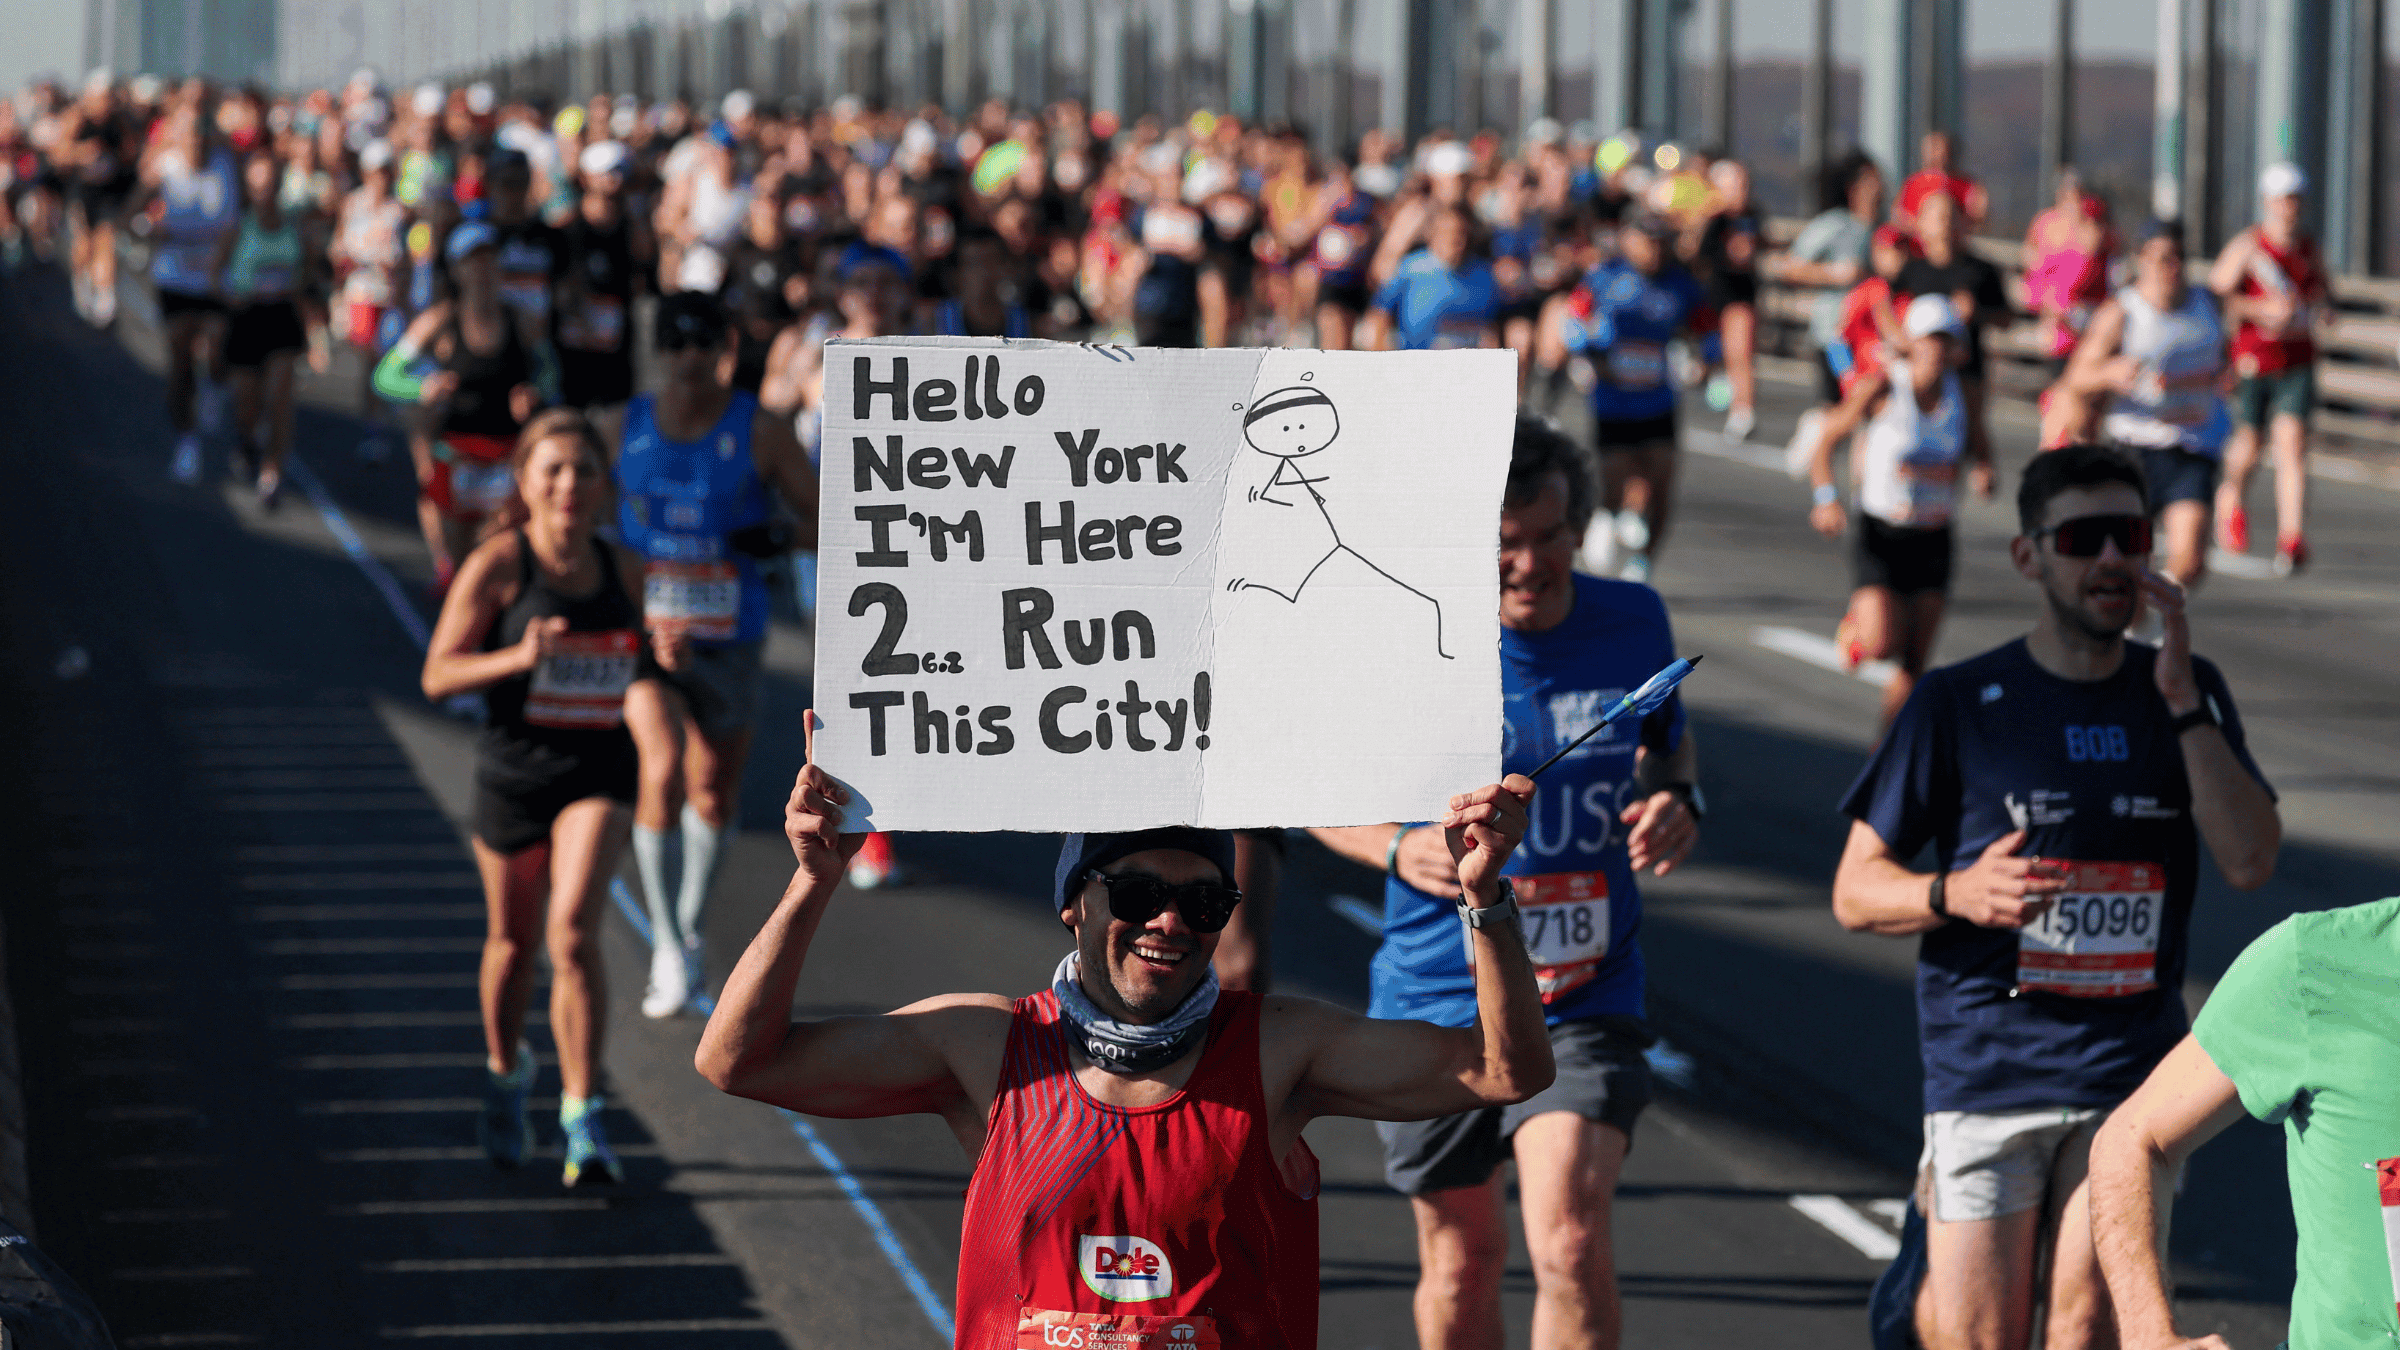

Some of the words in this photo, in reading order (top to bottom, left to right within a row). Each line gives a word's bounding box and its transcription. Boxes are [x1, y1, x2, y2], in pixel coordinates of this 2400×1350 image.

[853, 354, 1046, 422] Hello
[852, 434, 1017, 492] New
[1053, 428, 1189, 488] York
[1024, 500, 1183, 565] Here
[1001, 586, 1156, 670] Run
[848, 690, 1015, 757] This
[1038, 671, 1211, 754] City!
[2042, 896, 2151, 938] 15096
[1095, 1246, 1160, 1277] Dole
[1043, 1318, 1084, 1349] tcs
[1088, 1323, 1116, 1332] TATA
[1088, 1332, 1150, 1343] CONSULTANCY
